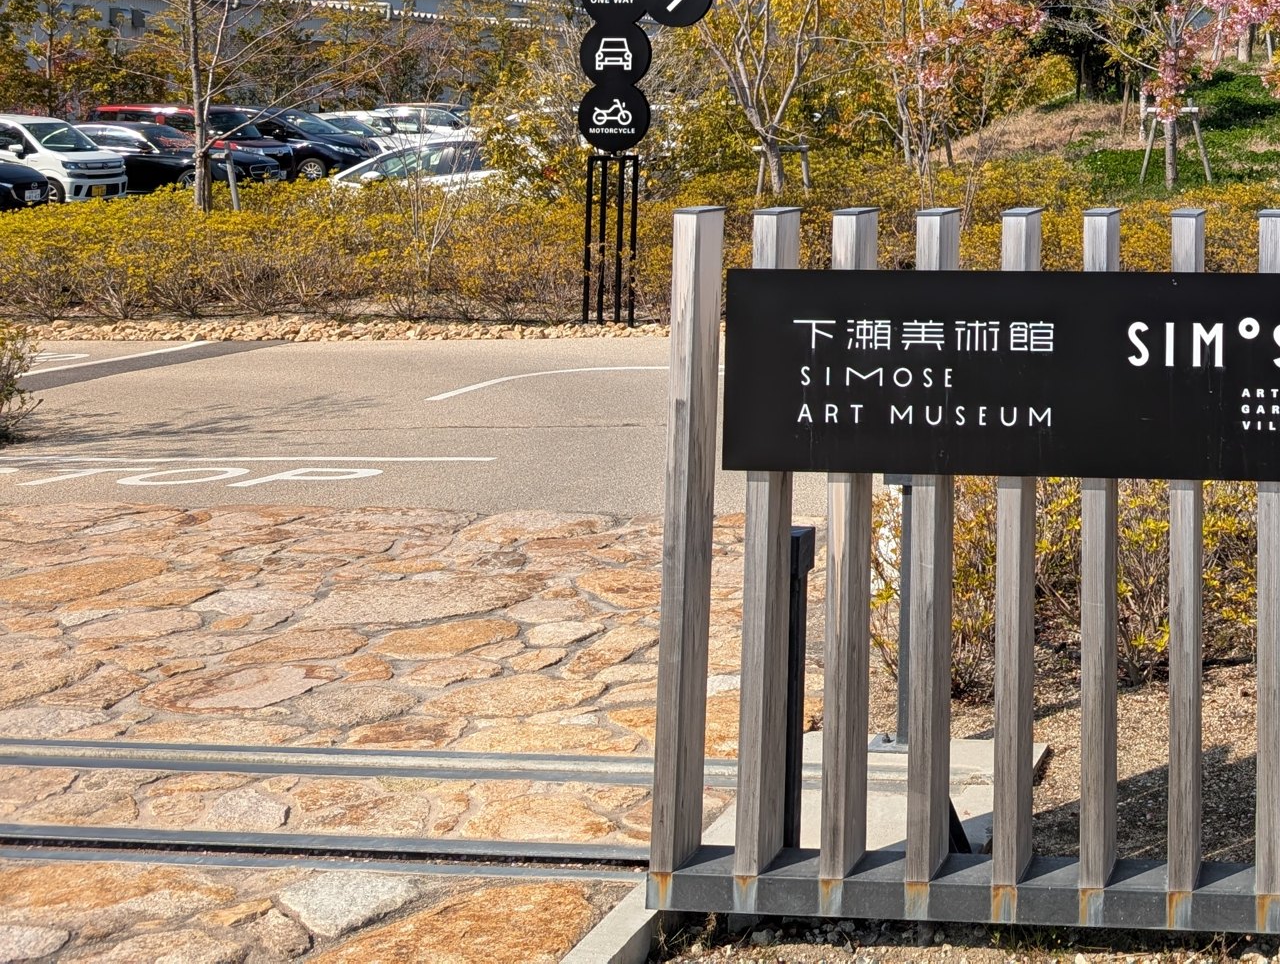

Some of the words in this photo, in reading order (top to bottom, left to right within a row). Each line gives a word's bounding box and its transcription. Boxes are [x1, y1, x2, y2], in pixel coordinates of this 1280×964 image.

[792, 318, 1055, 352] 下瀬美術館
[800, 365, 953, 388] SIMOSE
[1241, 387, 1279, 399] ART
[797, 403, 864, 424] ART
[890, 404, 1052, 427] MUSEUM
[0, 467, 384, 487] TOP
